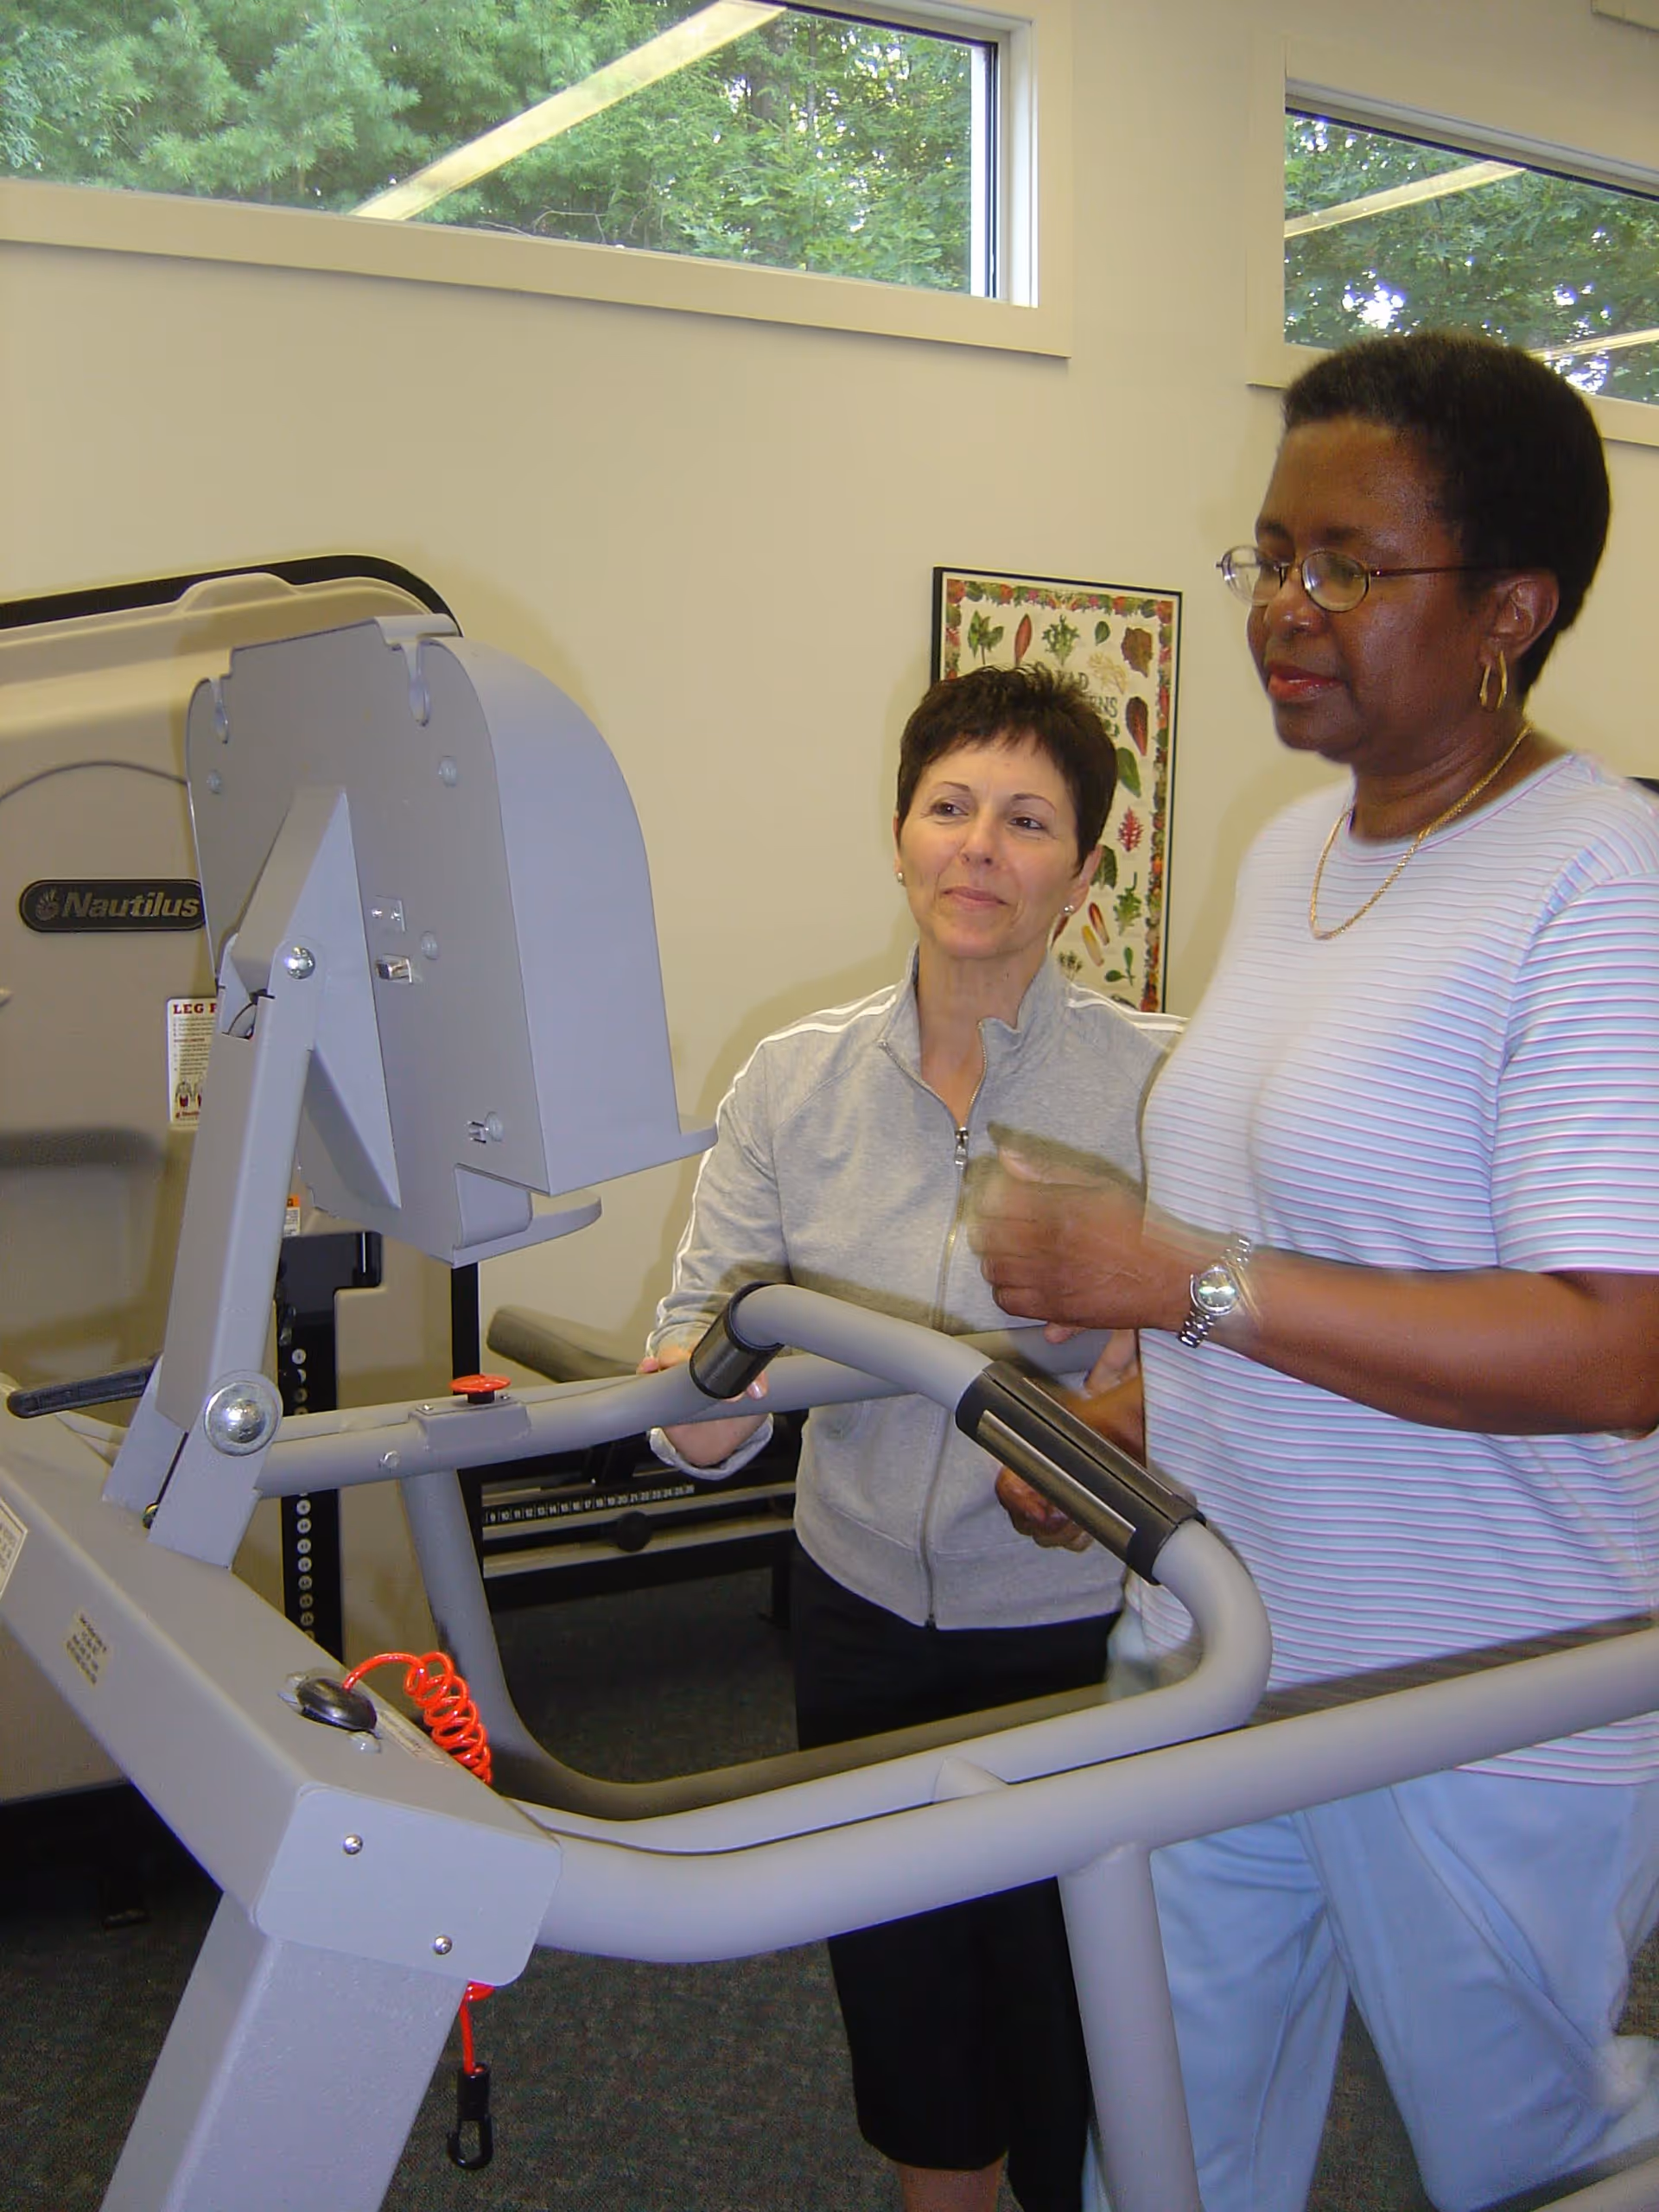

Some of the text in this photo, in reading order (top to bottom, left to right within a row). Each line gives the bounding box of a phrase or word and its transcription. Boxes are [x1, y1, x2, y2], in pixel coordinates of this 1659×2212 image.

[60, 891, 200, 918] Nautilus
[173, 1002, 205, 1014] LEG
[501, 1511, 511, 1521] 10
